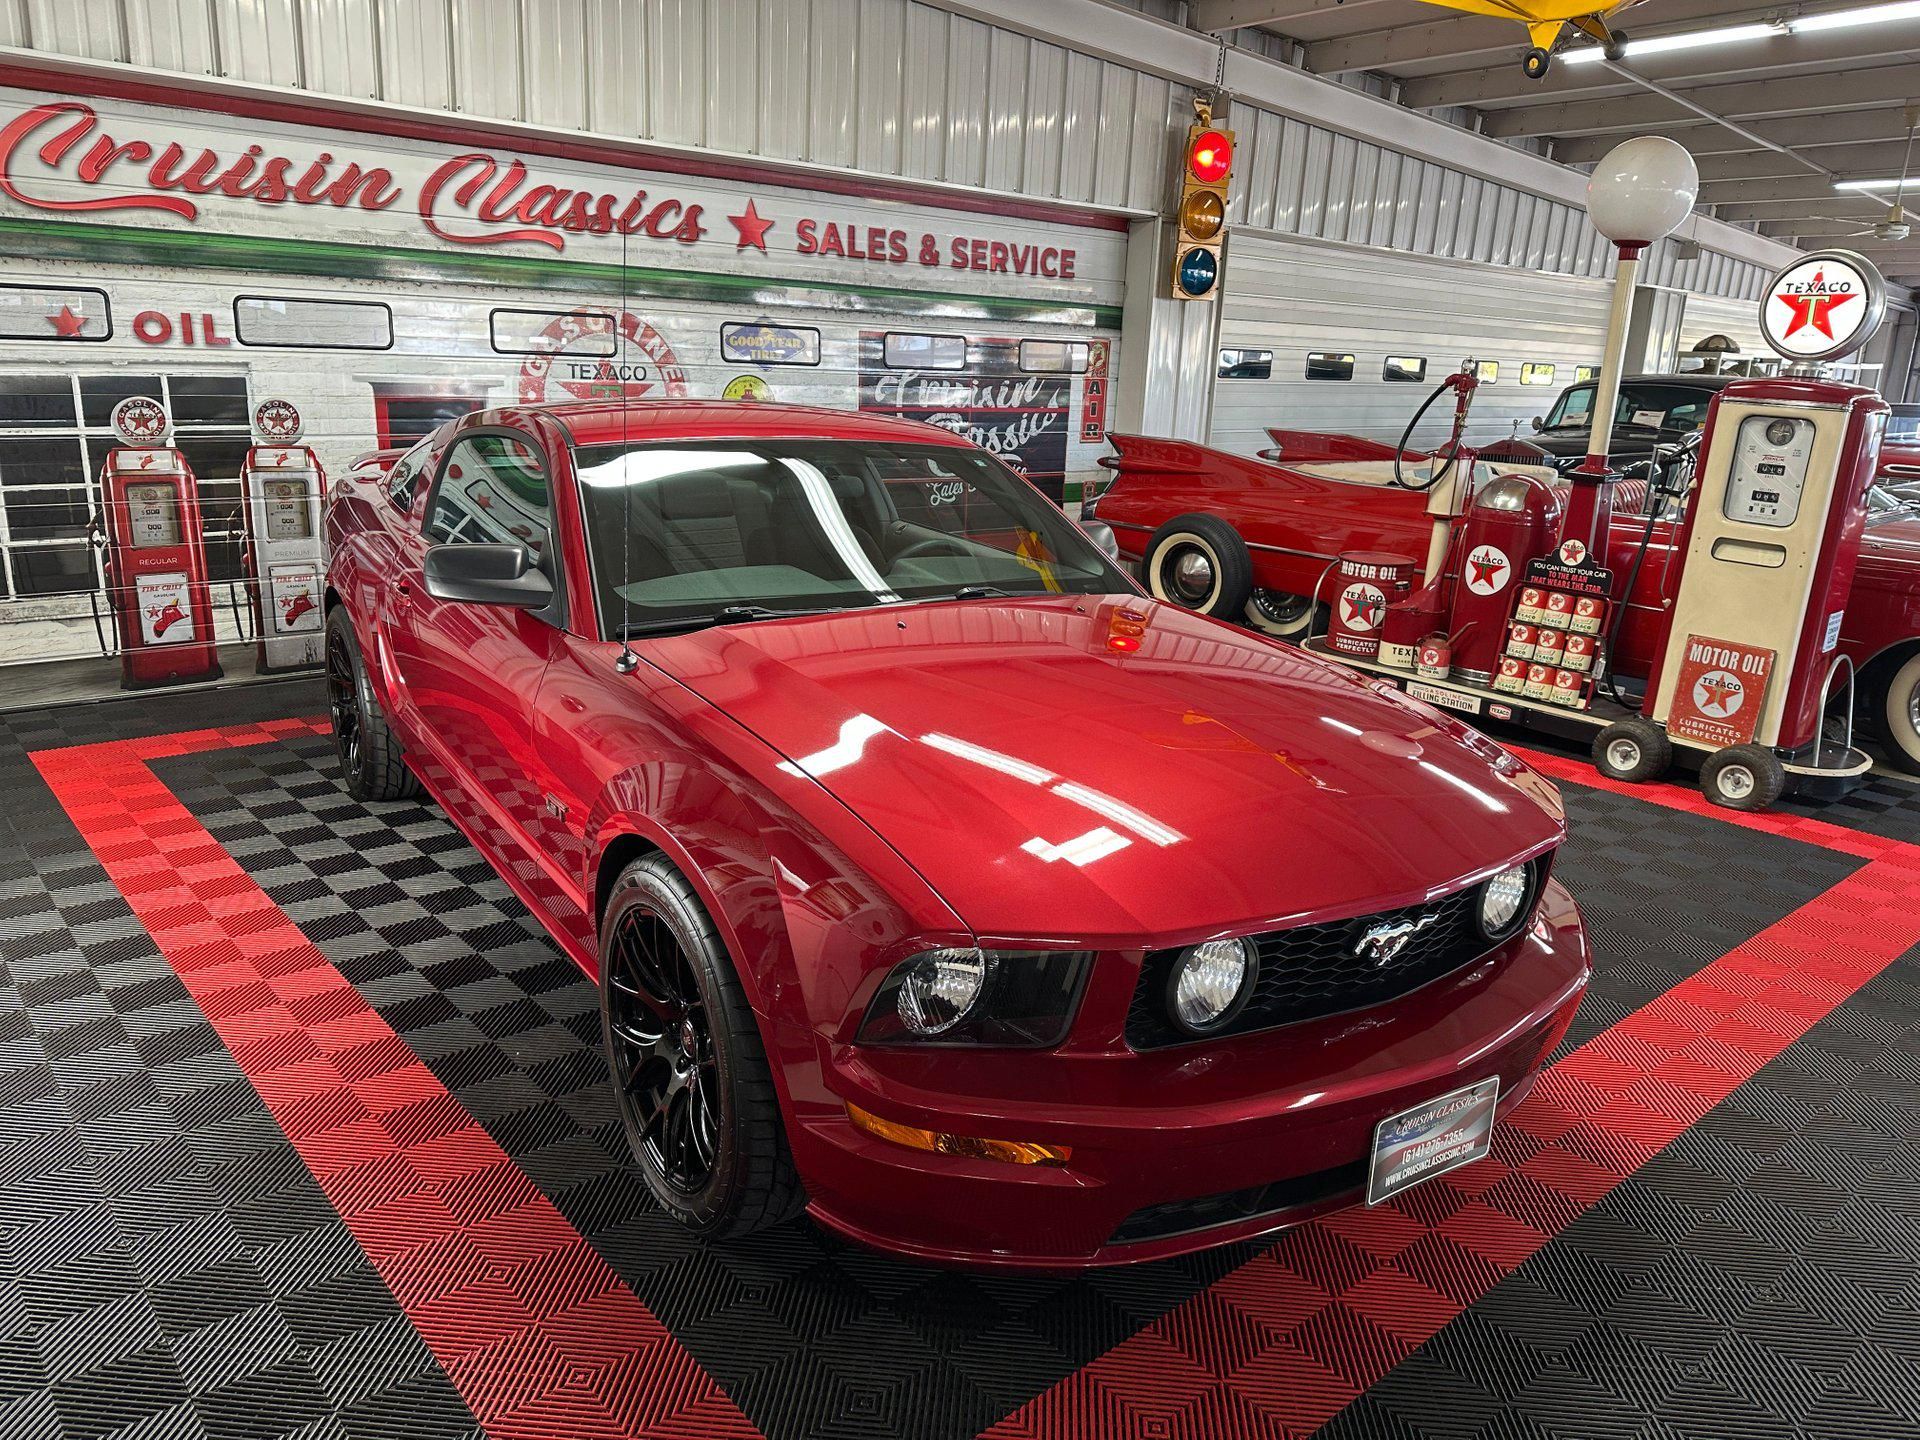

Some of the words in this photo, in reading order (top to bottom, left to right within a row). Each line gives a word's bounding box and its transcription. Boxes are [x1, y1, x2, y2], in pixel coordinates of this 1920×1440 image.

[0, 102, 402, 222] Cruisin
[418, 153, 707, 251] Classics
[796, 218, 909, 265] SALES
[918, 233, 940, 267] &
[951, 237, 1076, 279] SERVICE
[1785, 281, 1852, 294] TEXACO
[133, 310, 231, 345] OIL
[567, 363, 647, 381] TEXACO
[119, 400, 163, 418] GASOLINE
[257, 400, 298, 418] GASOLINE
[1084, 380, 1102, 437] AIR
[153, 424, 164, 436] OIL
[288, 424, 299, 435] OIL
[930, 481, 964, 506] Sales
[139, 557, 178, 566] REGULAR
[1472, 554, 1504, 565] TEXACO
[1341, 560, 1377, 579] MOTOR
[1380, 566, 1398, 580] OIL
[1534, 562, 1547, 570] YOU
[1546, 564, 1560, 572] CAN
[1560, 566, 1577, 574] TRUST
[1577, 568, 1594, 577] YOUR
[1594, 571, 1607, 579] CAR
[1558, 572, 1569, 580] THE
[1571, 574, 1588, 583] MAN
[1547, 578, 1571, 588] WEARS
[1572, 581, 1584, 590] THE
[1346, 590, 1384, 602] TEXACO
[1336, 636, 1378, 647] LUBRICATES
[1336, 642, 1376, 653] PERFECTLY
[1392, 646, 1419, 657] TEXA
[1689, 643, 1740, 670] MOTOR
[1742, 654, 1766, 676] OIL
[1702, 676, 1741, 691] TEXACO
[1413, 690, 1440, 702] FILLING
[1441, 698, 1473, 711] STATION
[1491, 707, 1509, 715] TEXACO
[1680, 718, 1741, 738] LUBRICATES
[1680, 726, 1737, 745] PERFECTLY
[545, 791, 569, 823] GT
[1396, 1109, 1437, 1136] CRUISIN
[1436, 1093, 1481, 1119] CLASSICS
[1402, 1143, 1424, 1165] (614)
[1384, 1140, 1475, 1187] WWW.CRUISINCLASSICSINC.COM
